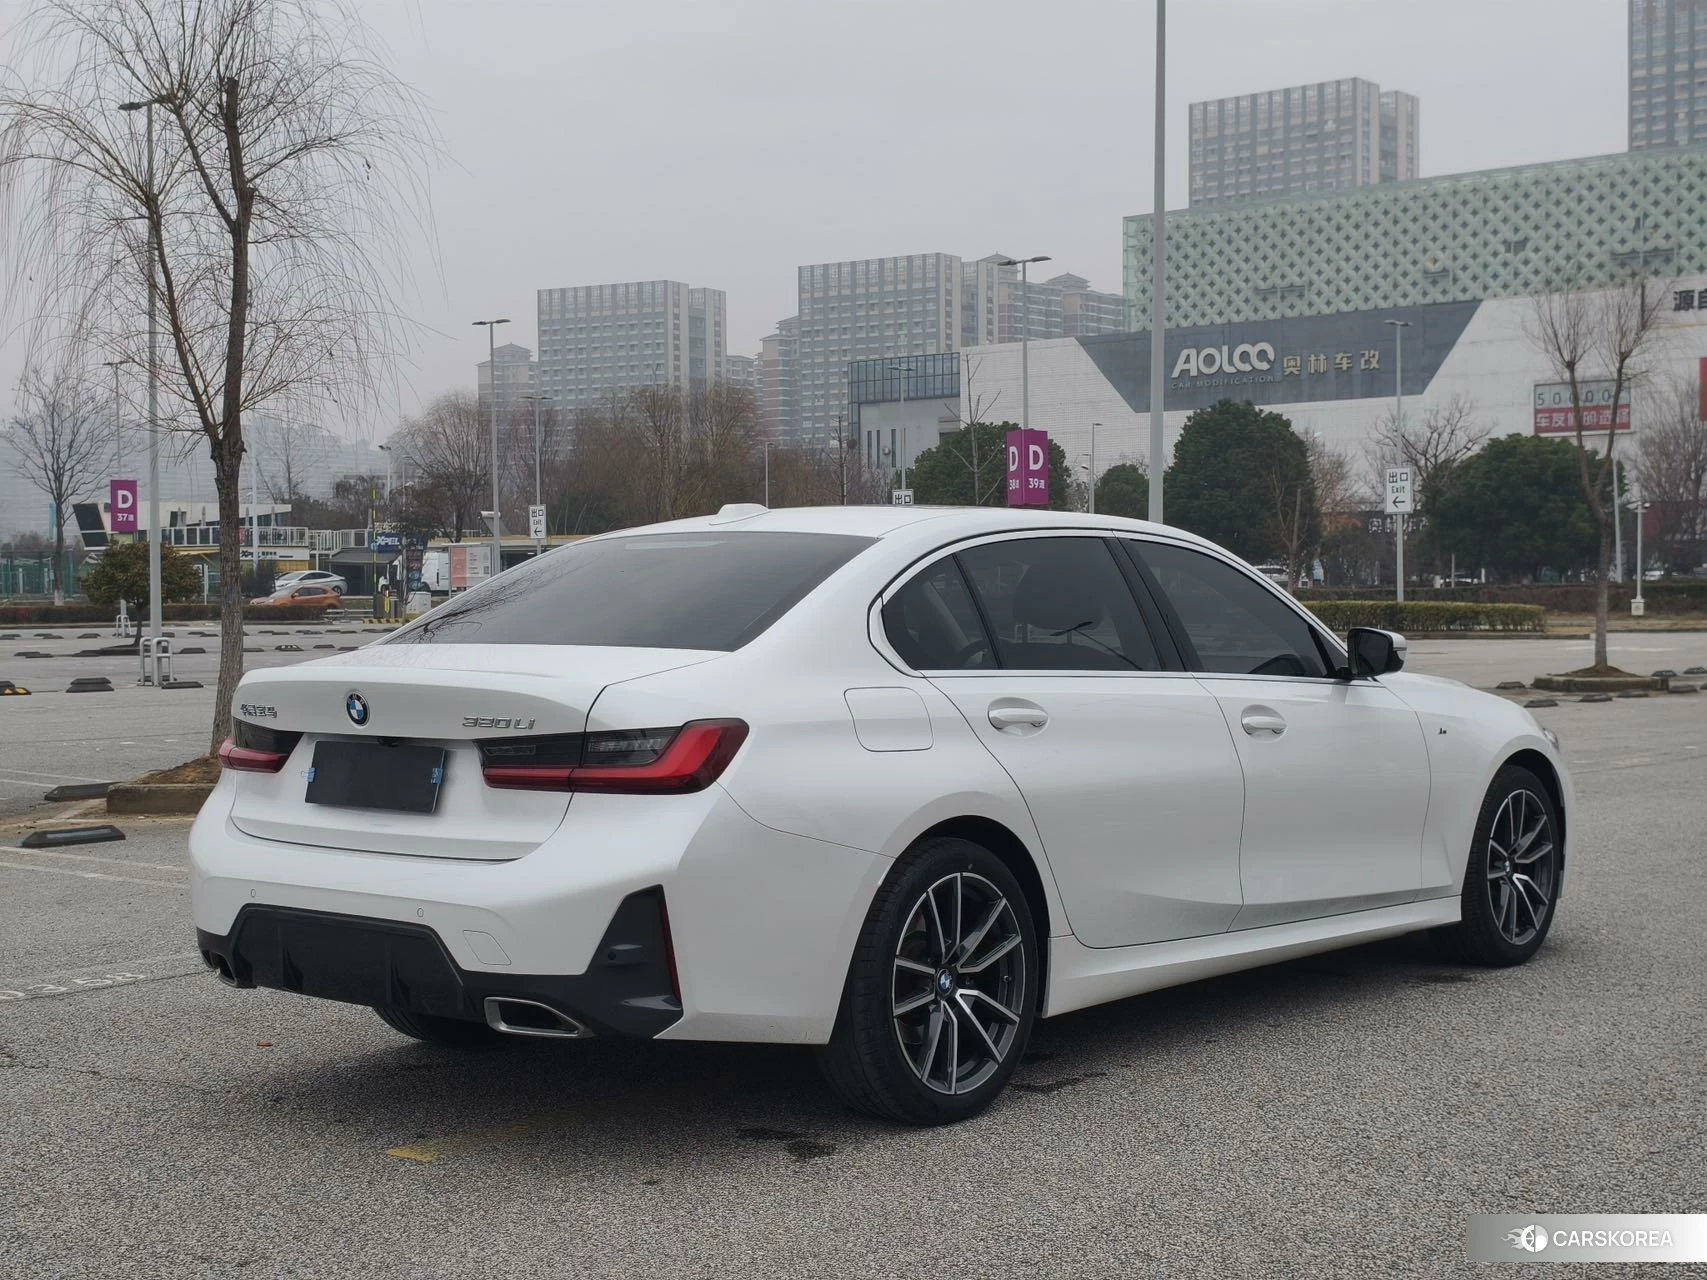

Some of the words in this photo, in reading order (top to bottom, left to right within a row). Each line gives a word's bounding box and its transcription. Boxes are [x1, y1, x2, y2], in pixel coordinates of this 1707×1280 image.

[1283, 350, 1380, 376] 奥林车改
[1009, 446, 1018, 471] D
[1029, 445, 1043, 470] D
[1389, 472, 1408, 483] 出口
[118, 490, 133, 508] D
[1392, 486, 1405, 494] Exit
[532, 509, 543, 517] 出口
